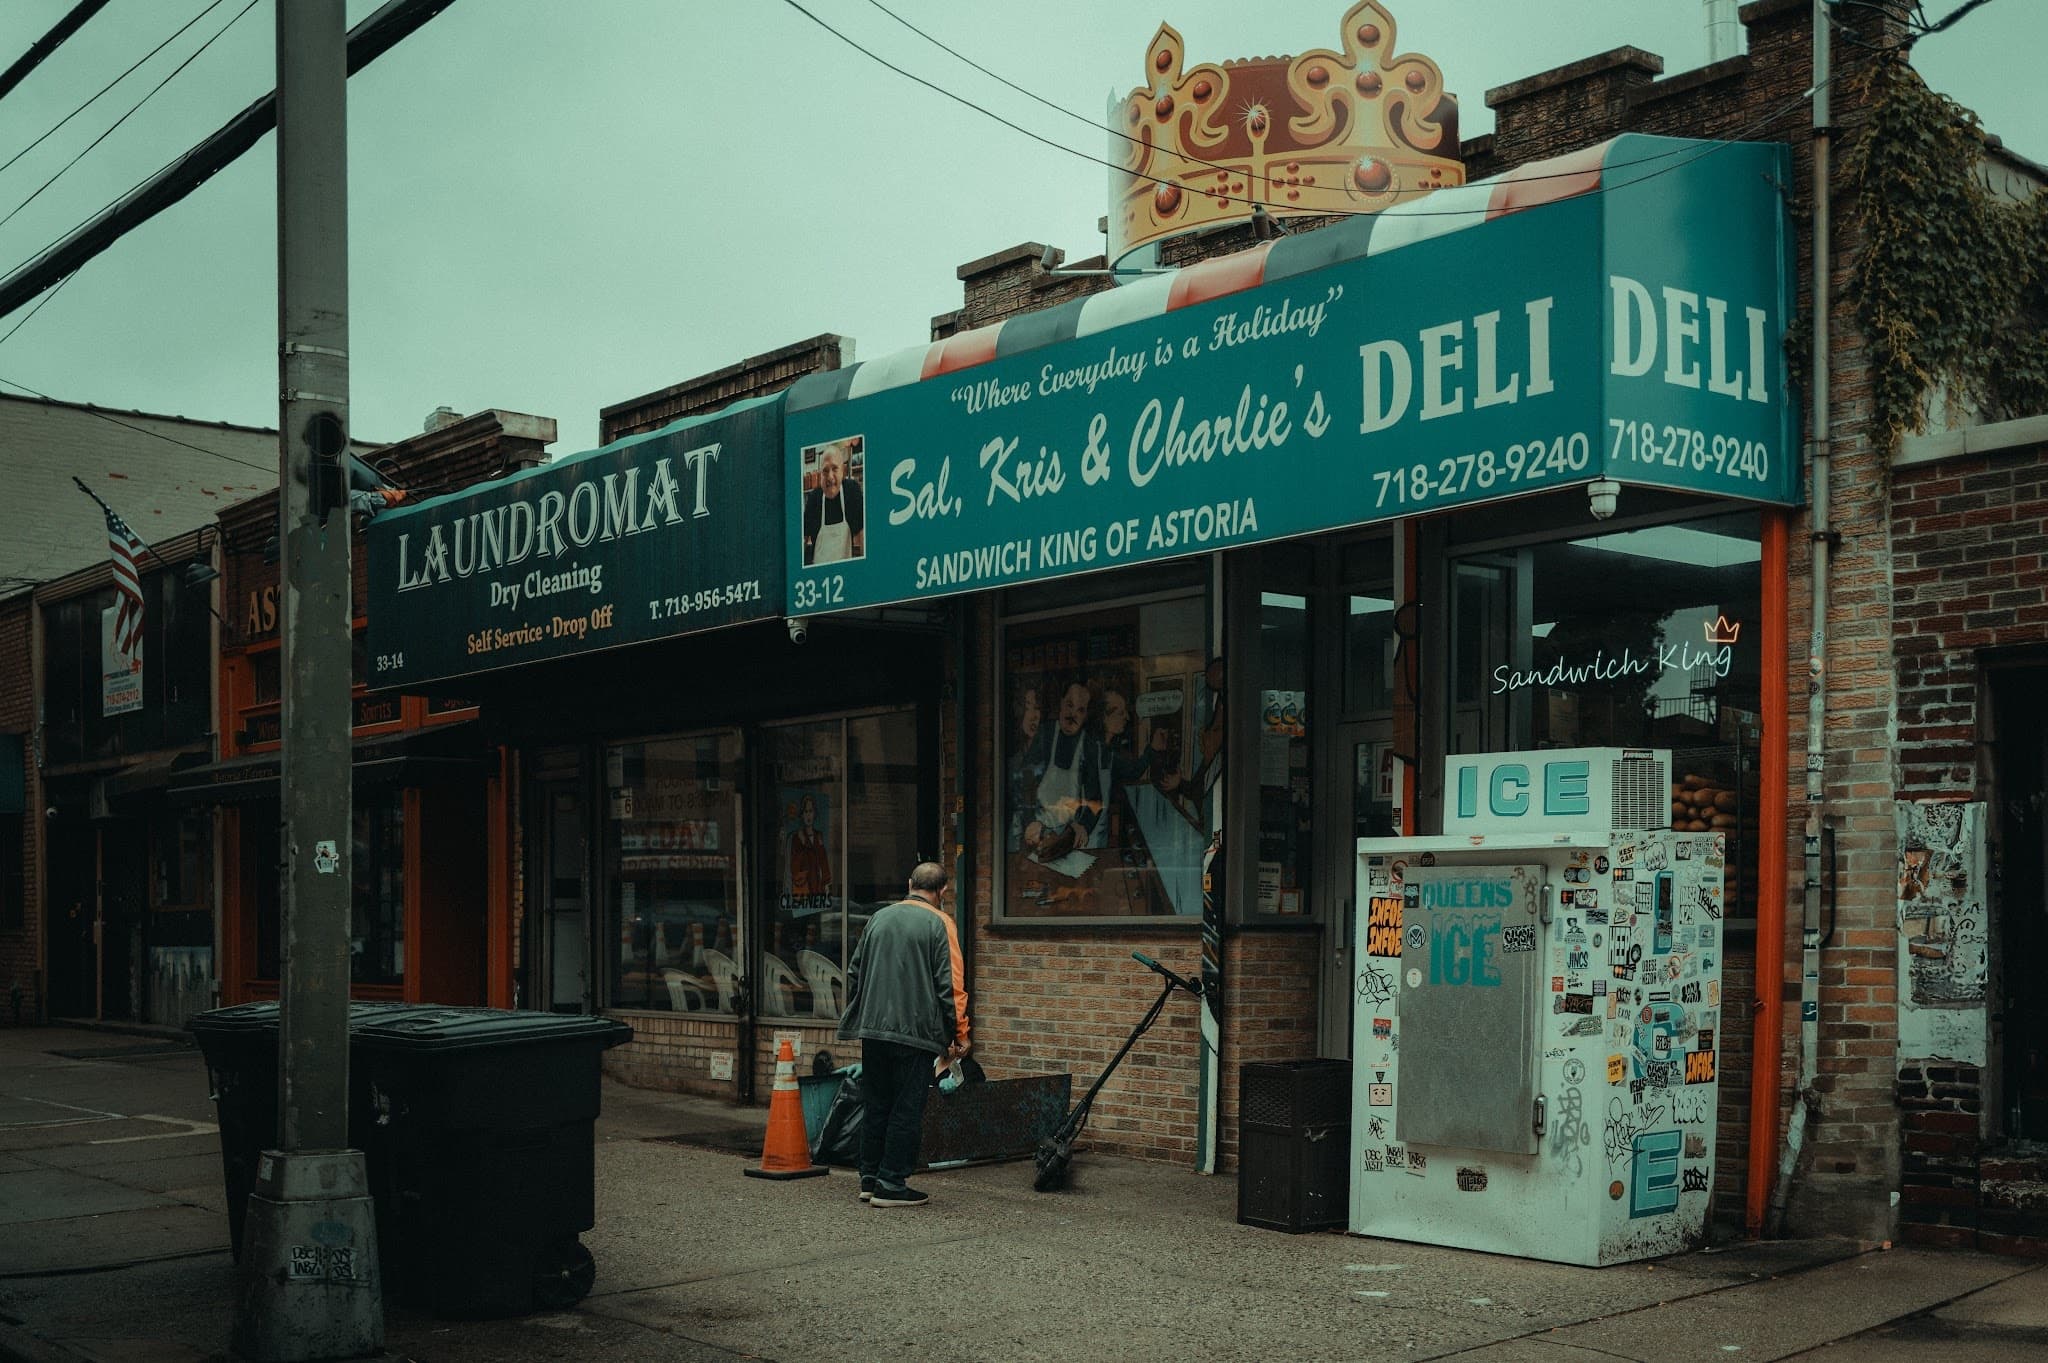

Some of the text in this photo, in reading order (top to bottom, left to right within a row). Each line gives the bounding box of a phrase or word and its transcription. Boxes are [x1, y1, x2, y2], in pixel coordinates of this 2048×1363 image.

[1039, 349, 1148, 397] Everyday
[1154, 336, 1174, 365] is
[1182, 337, 1201, 359] a
[1359, 296, 1555, 435] DELI
[1609, 274, 1769, 404] DELI
[888, 363, 1332, 527] Sal, Kris & Charlie's
[1373, 432, 1590, 508] 718-278-9240
[1609, 418, 1769, 483] 718-278-9240
[398, 442, 722, 592] LAUNDROMAT
[916, 497, 1259, 590] SANDWICH KING OF ASTORIA
[490, 561, 602, 612] Dry Cleaning
[665, 579, 761, 618] 718-956-5471
[794, 575, 845, 609] 33-12
[467, 604, 613, 655] Self Service Drop Off
[376, 652, 404, 671] 33-14
[1492, 640, 1732, 695] Sandwich King
[1457, 760, 1590, 818] ICE
[780, 893, 832, 910] CLEANERS
[1422, 878, 1513, 910] QUEENS
[1429, 912, 1503, 987] ICE
